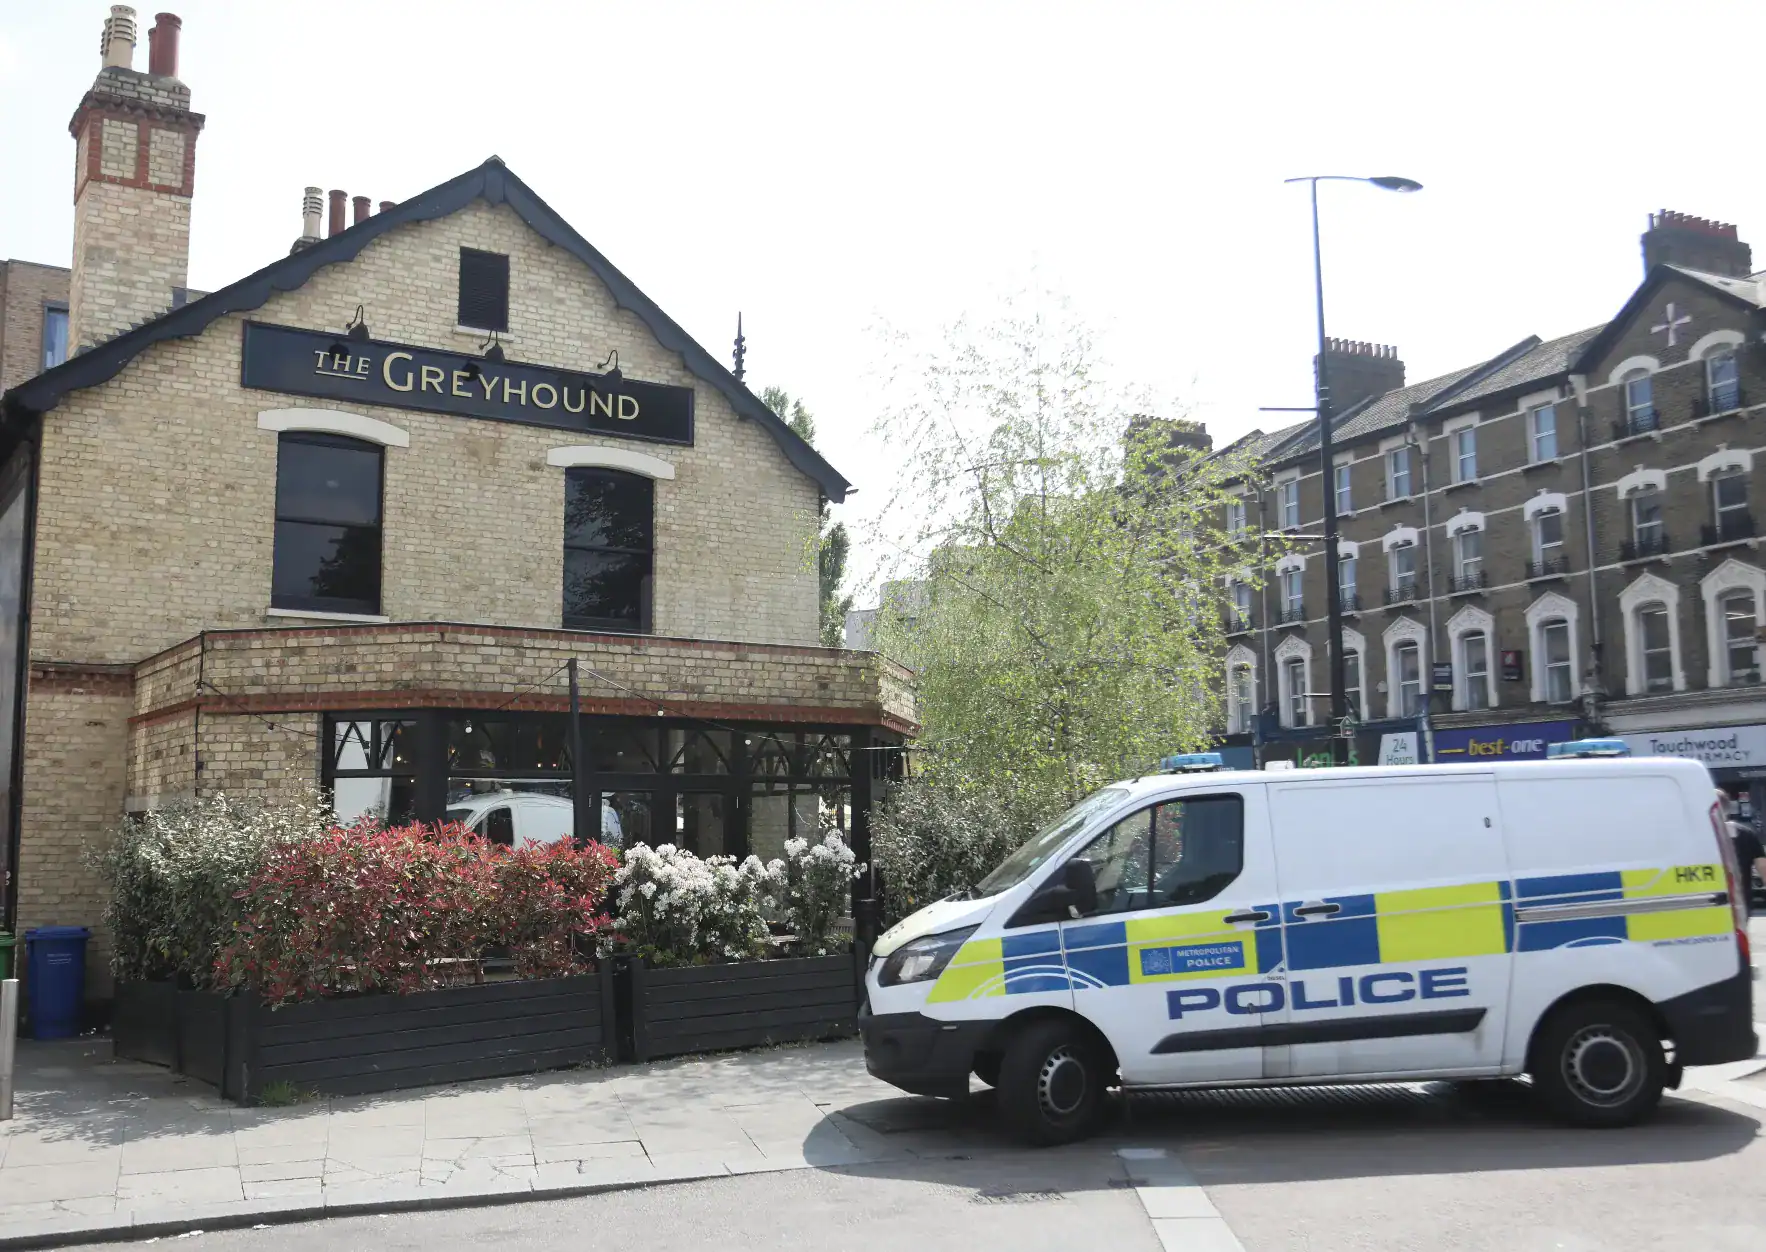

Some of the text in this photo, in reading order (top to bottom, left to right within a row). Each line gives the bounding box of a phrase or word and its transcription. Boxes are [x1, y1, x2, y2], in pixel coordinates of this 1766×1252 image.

[315, 350, 640, 421] THE GREYHOUND
[1392, 738, 1408, 753] 24
[1468, 738, 1543, 756] best-one
[1650, 733, 1738, 754] Touchwood
[1385, 754, 1414, 766] Hours
[1675, 866, 1716, 883] HKR
[1176, 946, 1240, 957] METROPOLITAN
[1186, 956, 1232, 968] POLICE
[1166, 966, 1470, 1021] POLICE
